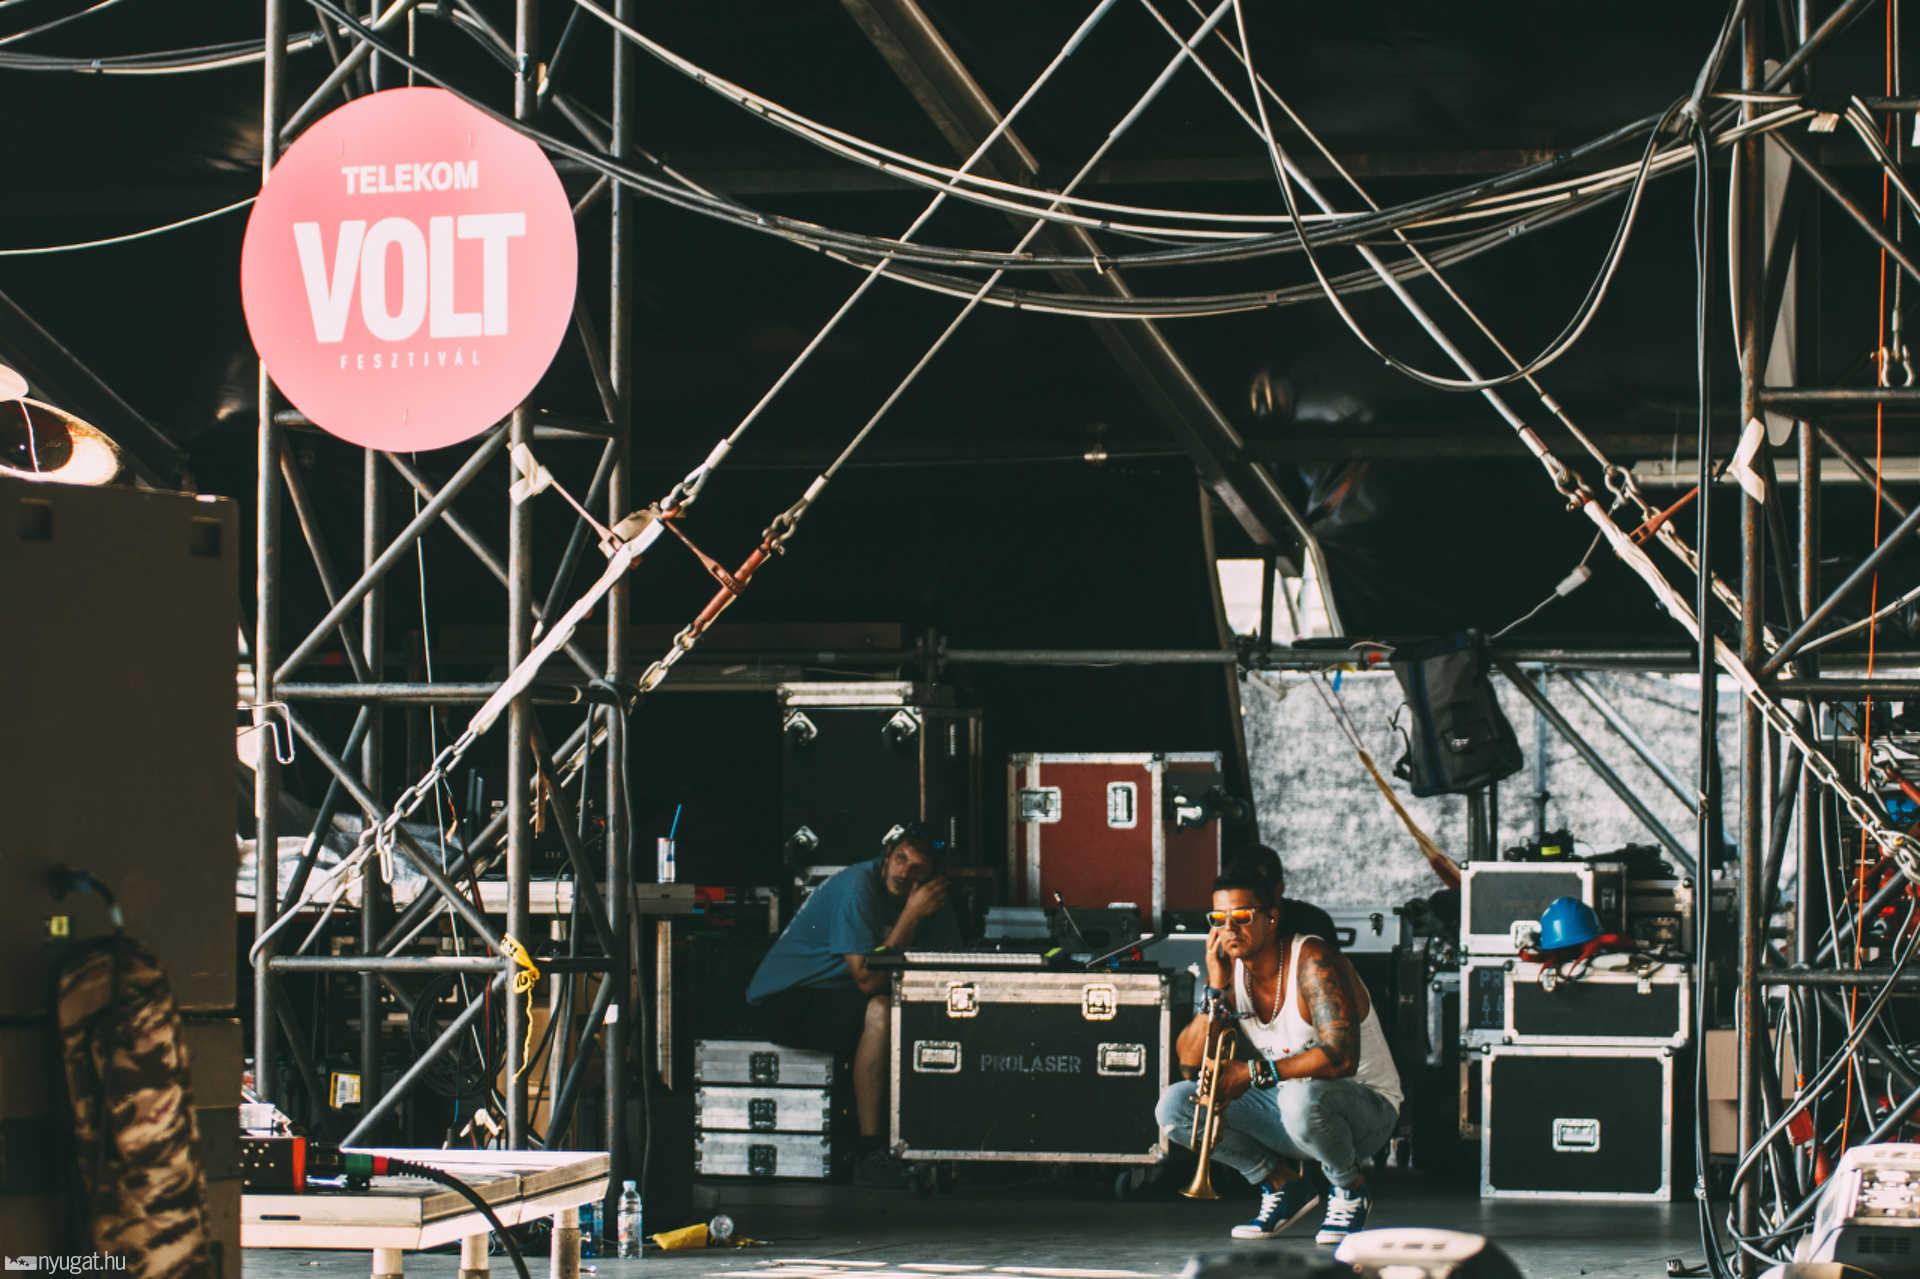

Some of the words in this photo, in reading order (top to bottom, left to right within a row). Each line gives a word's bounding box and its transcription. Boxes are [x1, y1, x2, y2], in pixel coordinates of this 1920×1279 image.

[341, 160, 479, 195] TELEKOM
[292, 212, 526, 343] VOLT
[340, 347, 480, 370] FESZTIVÁL
[980, 1054, 1081, 1073] PROLASER
